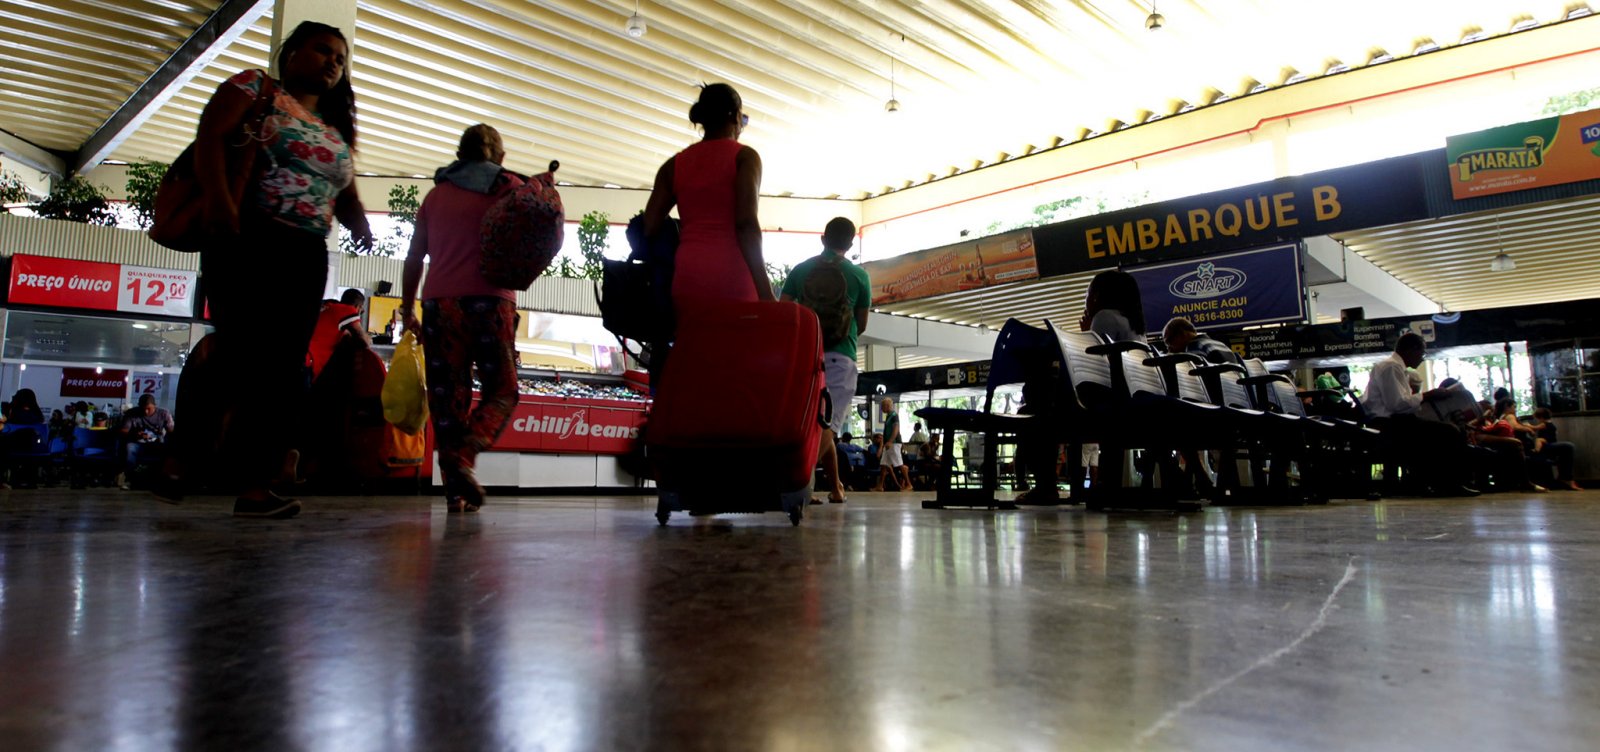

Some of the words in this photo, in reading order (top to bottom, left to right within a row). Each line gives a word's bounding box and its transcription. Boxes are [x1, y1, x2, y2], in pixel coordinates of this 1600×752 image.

[1471, 146, 1539, 170] MARATÁ
[1085, 192, 1299, 259] EMBARQUE
[1312, 185, 1342, 221] B
[17, 273, 66, 291] PREÇO
[69, 275, 112, 293] ÚNICO
[127, 271, 167, 279] QUALQUER
[1183, 275, 1234, 295] SINART
[1172, 299, 1219, 314] ANUNCIE
[1220, 296, 1248, 309] AQUI
[1194, 309, 1244, 323] 3616-8300
[1249, 343, 1262, 351] São
[1263, 341, 1294, 349] Matheus
[1324, 343, 1353, 353] Expresso
[1353, 340, 1385, 348] Candeias
[66, 379, 94, 389] PREÇO
[96, 378, 123, 388] ÚNICO
[967, 370, 978, 384] B
[513, 416, 571, 435] chilli
[575, 421, 640, 439] beans
